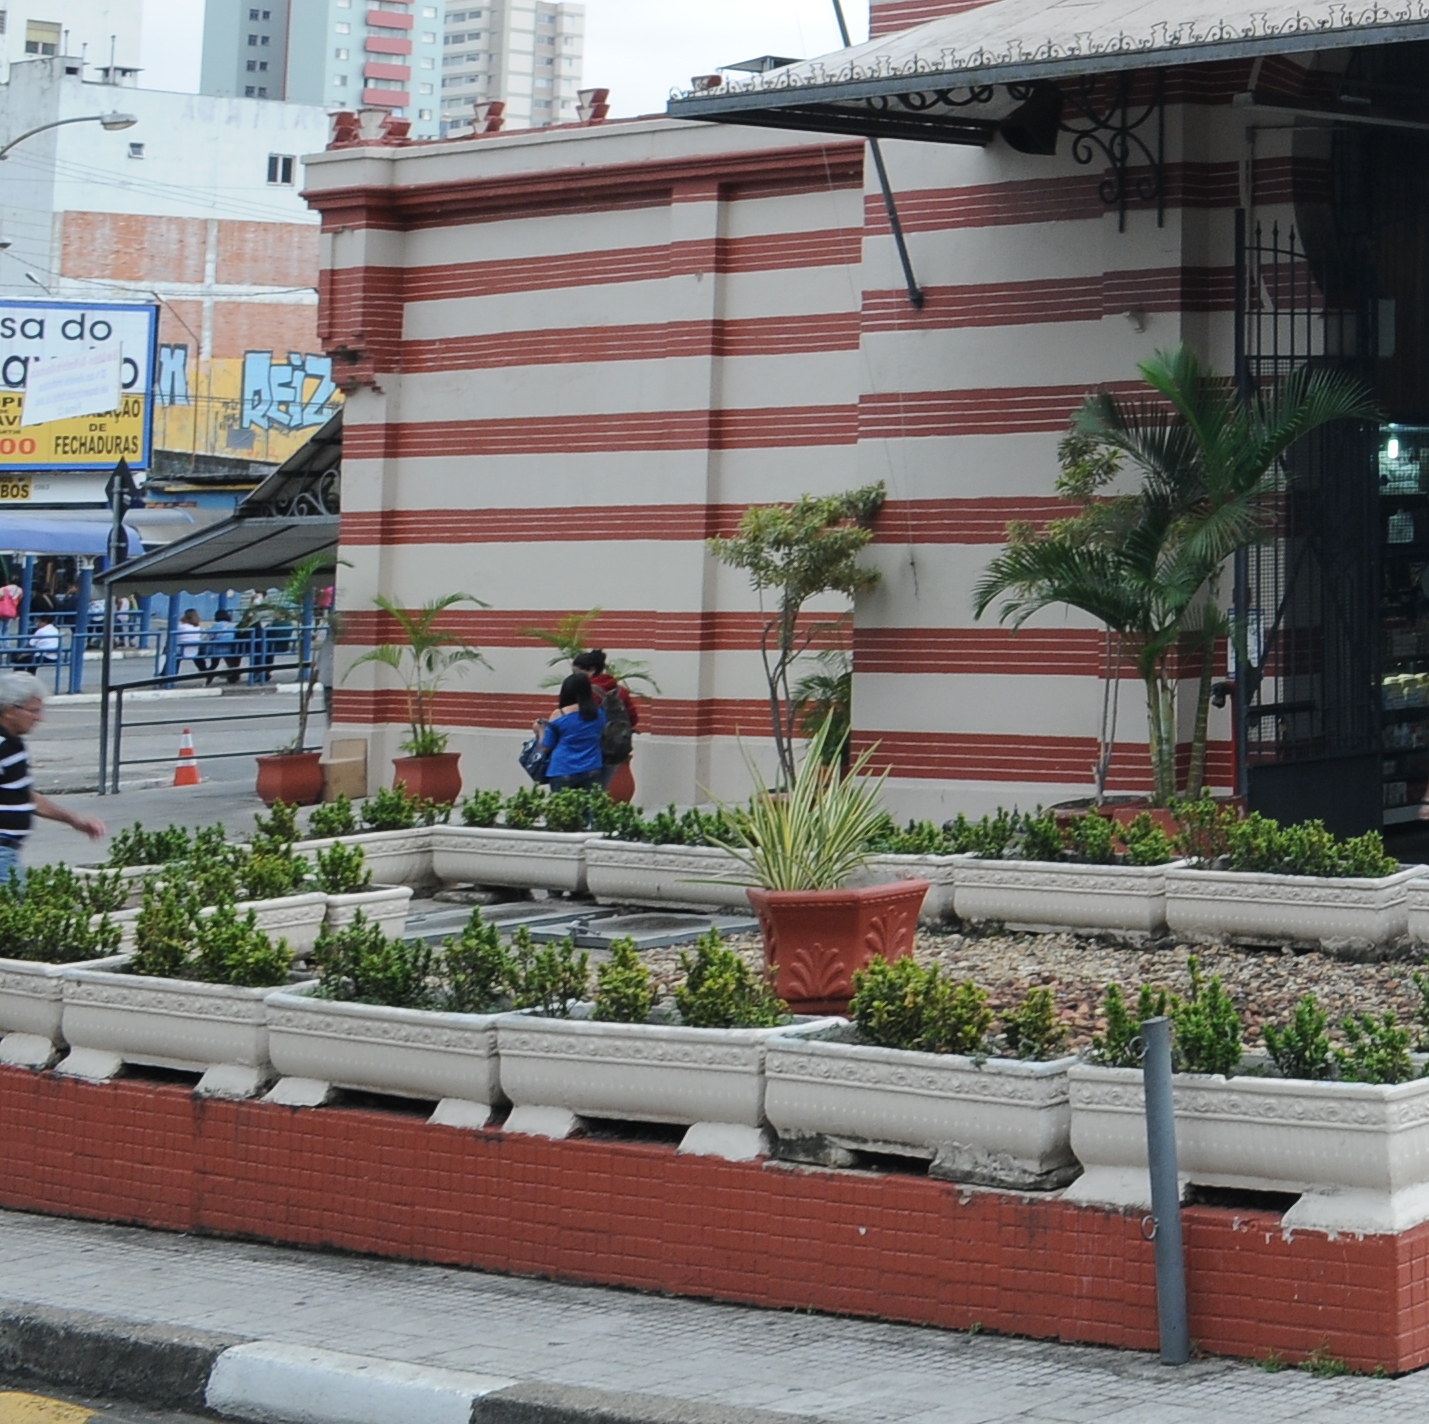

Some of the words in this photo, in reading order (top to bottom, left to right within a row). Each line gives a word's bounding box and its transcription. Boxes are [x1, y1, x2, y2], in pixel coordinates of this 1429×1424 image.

[61, 313, 112, 341] do
[88, 423, 107, 432] DE
[54, 435, 139, 455] FECHADURAS
